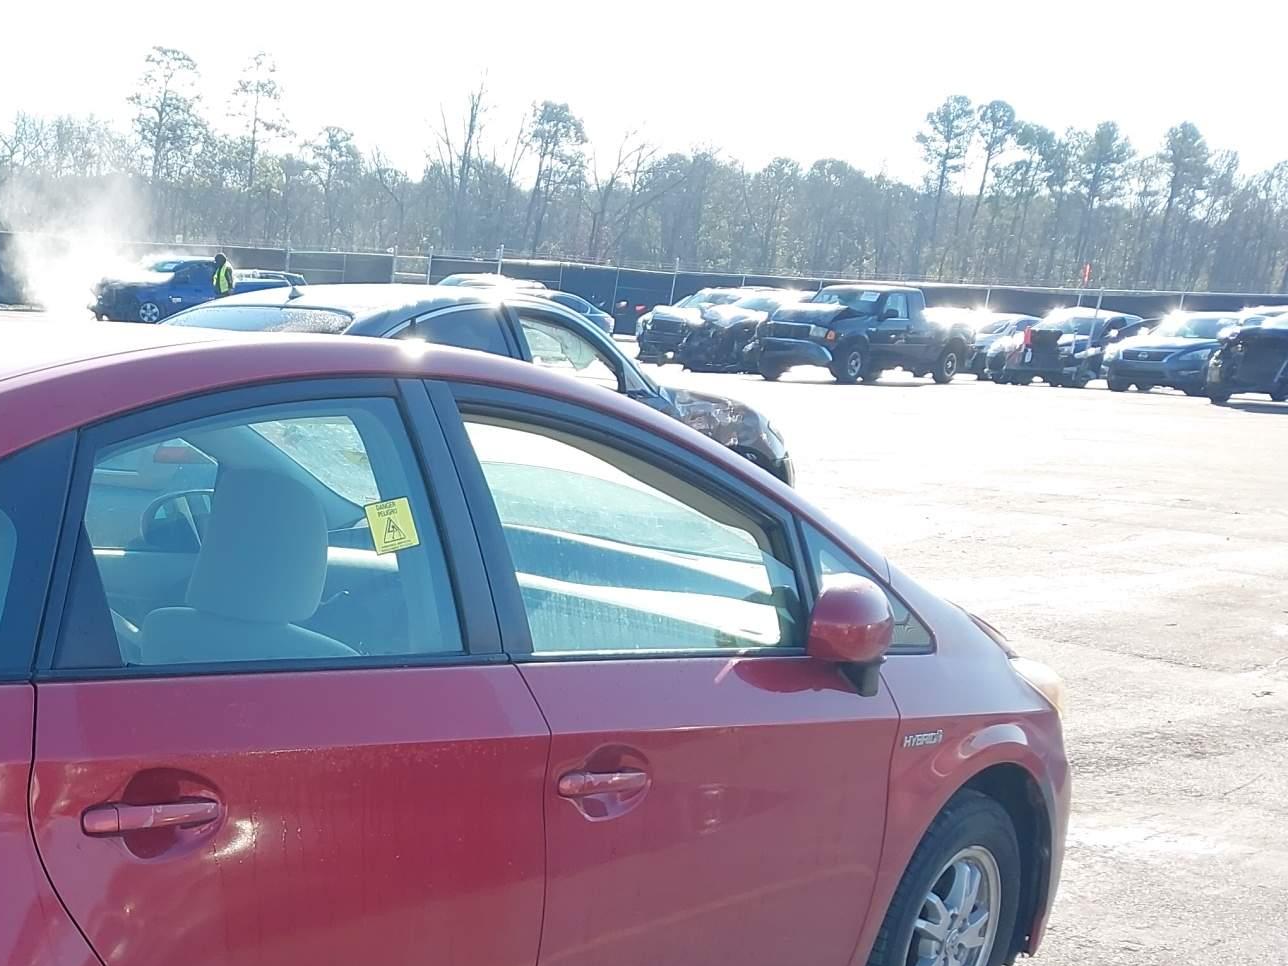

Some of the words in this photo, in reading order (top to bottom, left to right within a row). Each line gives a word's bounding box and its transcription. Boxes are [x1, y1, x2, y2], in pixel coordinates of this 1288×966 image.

[376, 502, 396, 511] DANGER
[377, 508, 398, 518] PELIGRO
[904, 730, 943, 748] HYBRID
